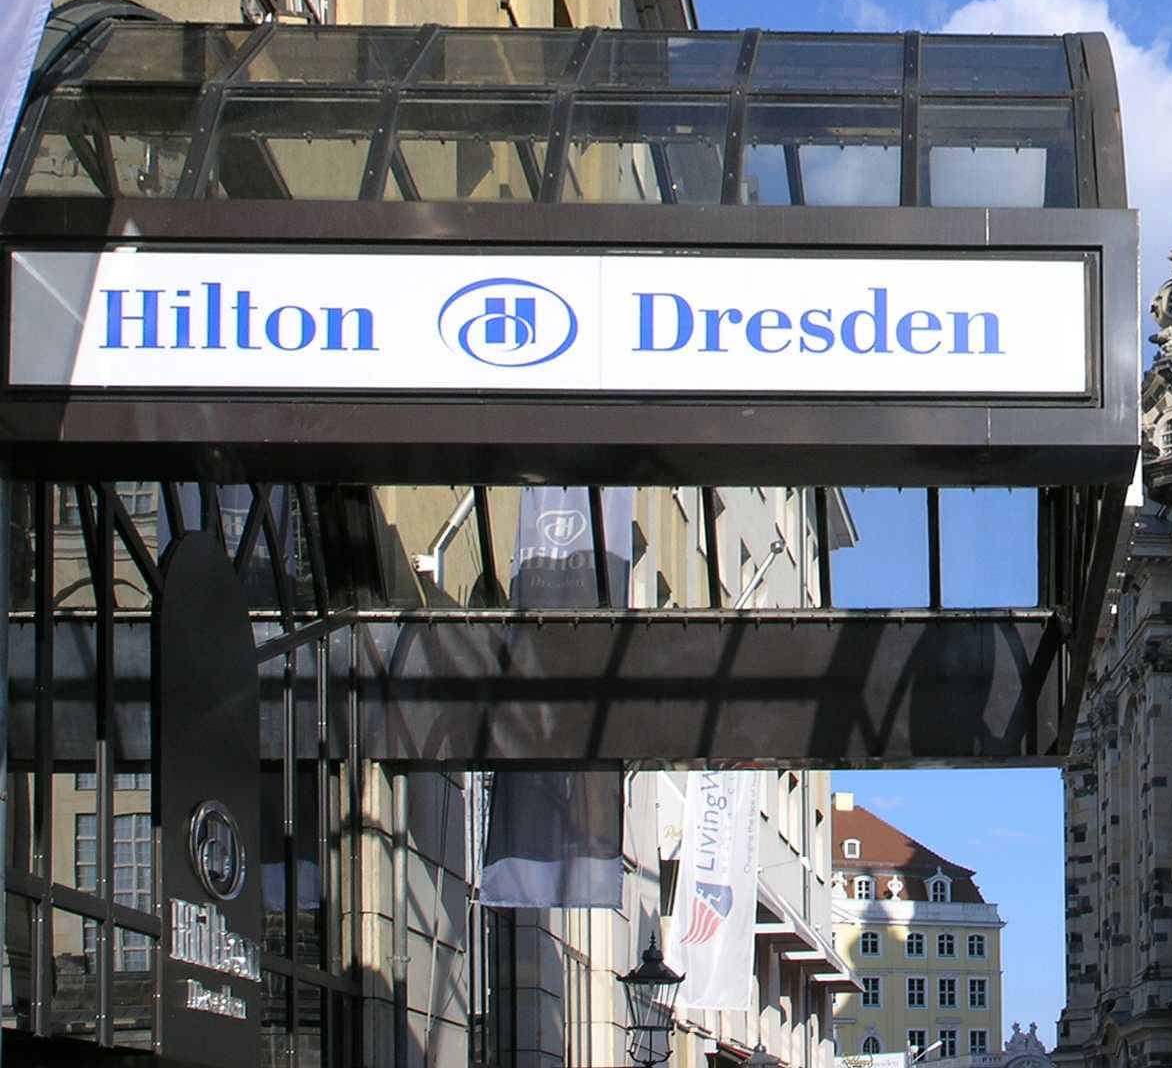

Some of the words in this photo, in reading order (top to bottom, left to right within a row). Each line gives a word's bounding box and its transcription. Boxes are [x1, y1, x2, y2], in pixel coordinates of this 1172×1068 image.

[98, 282, 380, 351] Hilton
[631, 287, 1006, 355] Dresden
[168, 898, 262, 982] Hilton
